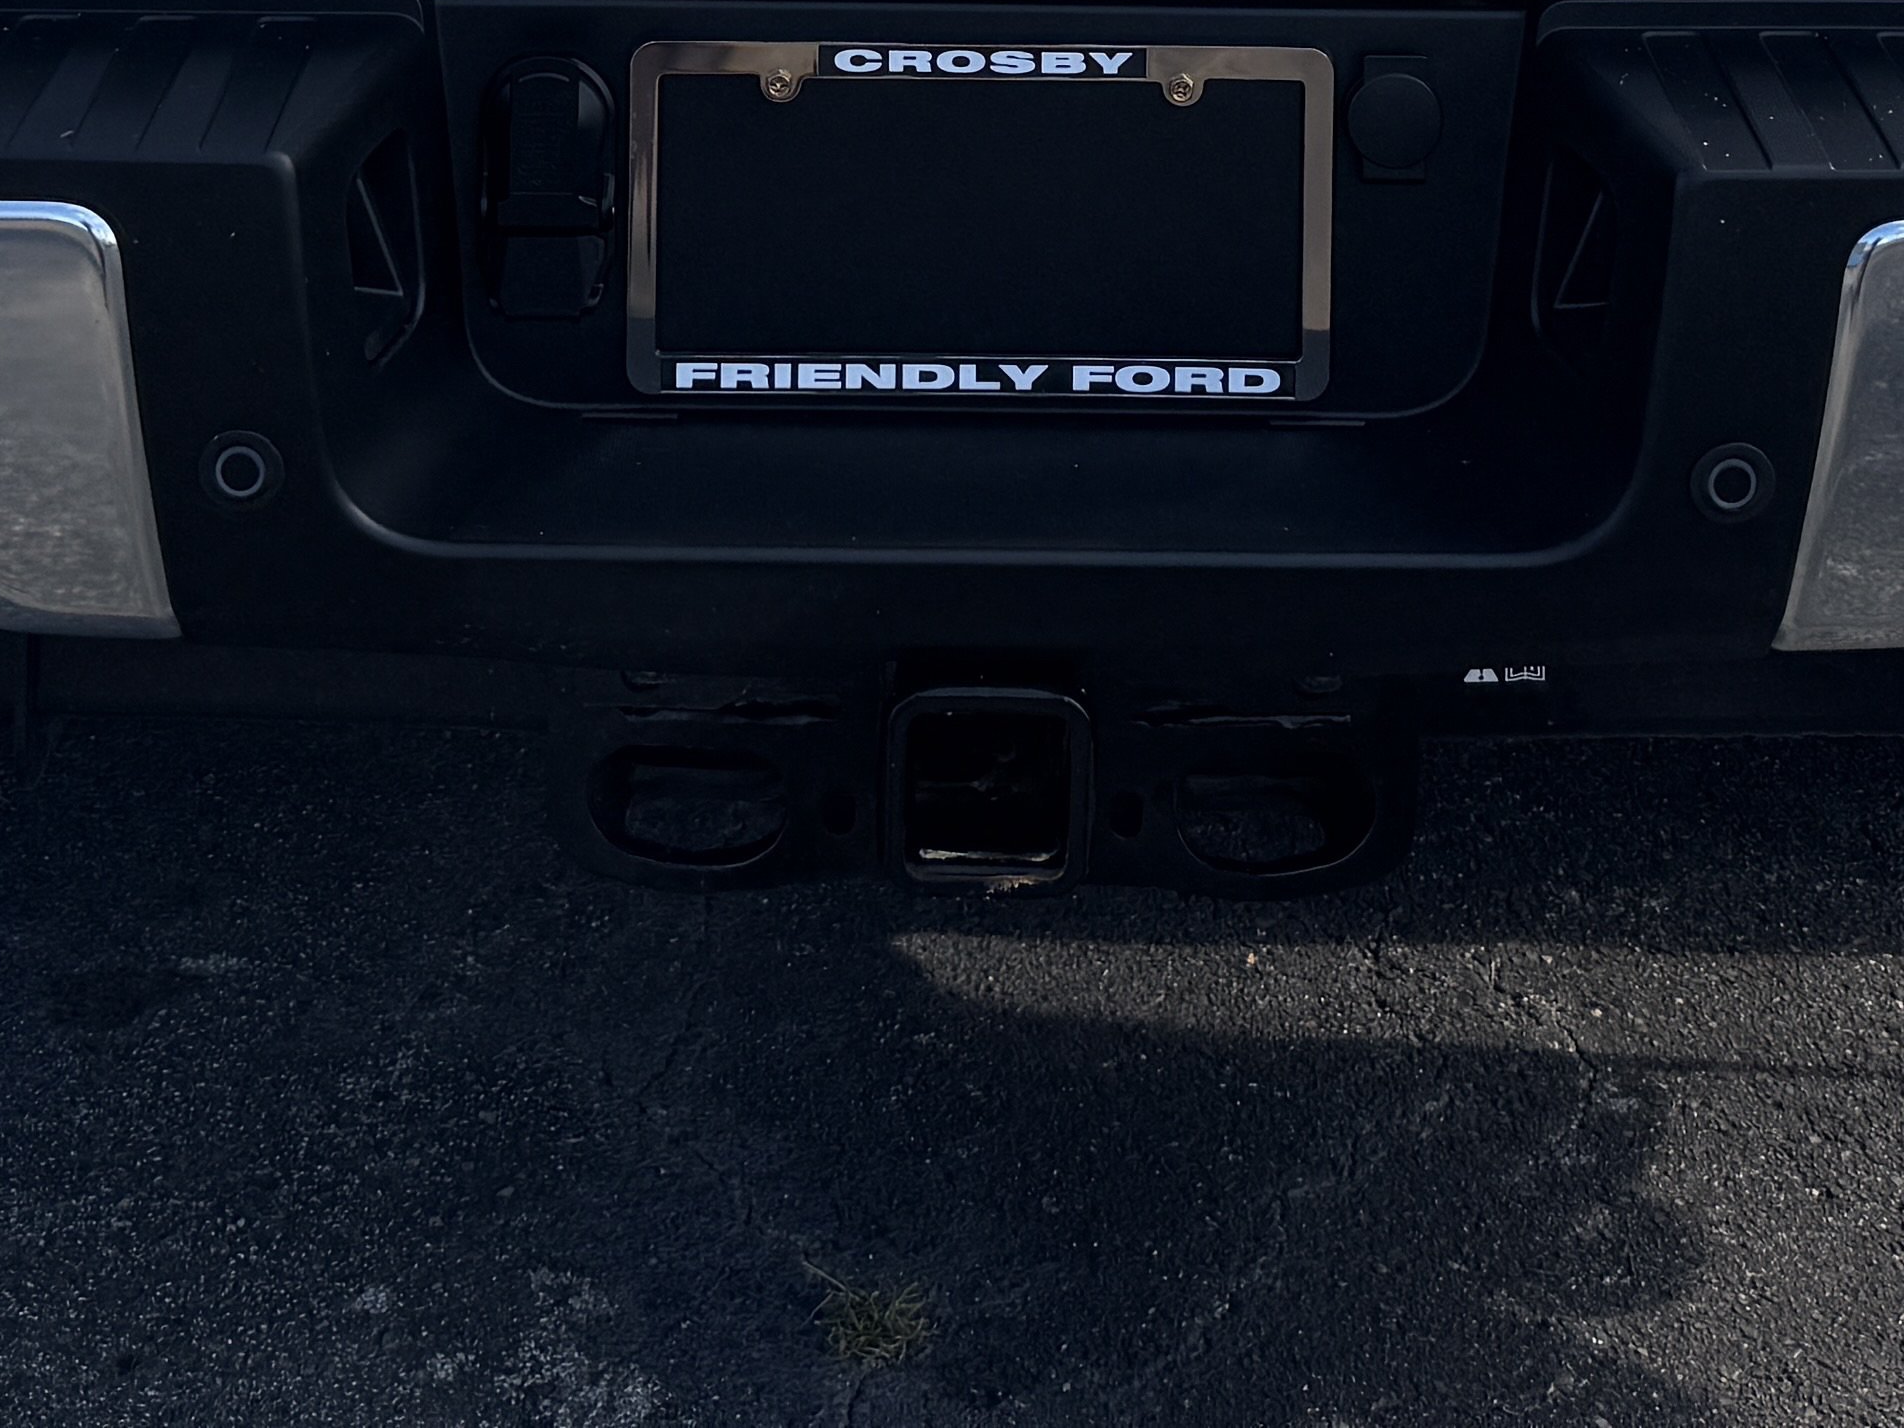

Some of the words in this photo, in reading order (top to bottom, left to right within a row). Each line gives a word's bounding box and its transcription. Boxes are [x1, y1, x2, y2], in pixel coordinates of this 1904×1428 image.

[833, 48, 1133, 75] CROSBY
[675, 361, 1049, 392] FRIENDLY
[1072, 365, 1281, 394] FORD
